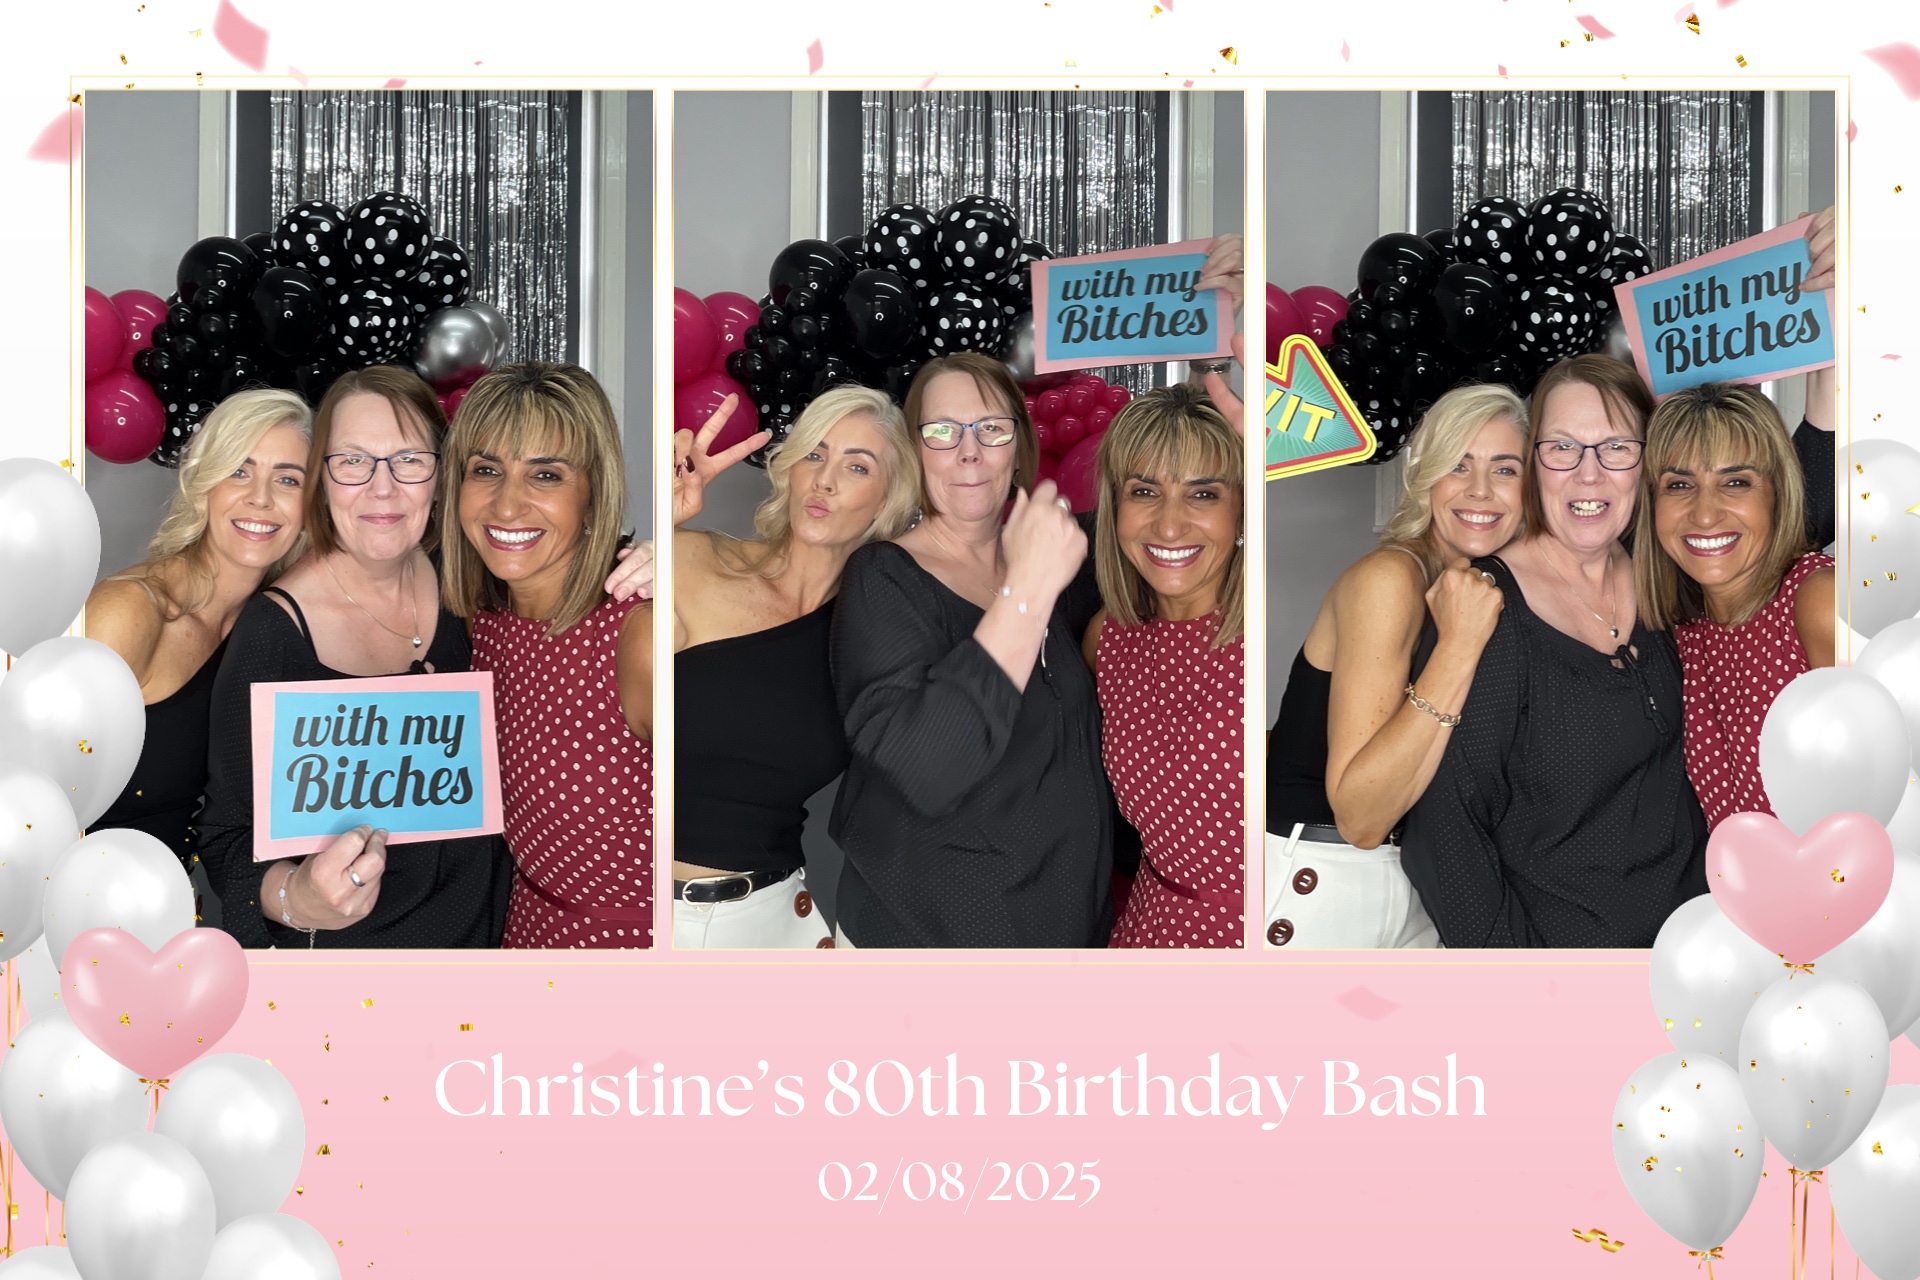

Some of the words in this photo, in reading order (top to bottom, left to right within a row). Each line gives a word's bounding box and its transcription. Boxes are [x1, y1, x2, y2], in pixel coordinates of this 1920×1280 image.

[1061, 268, 1135, 301] with
[1144, 270, 1202, 302] my
[1652, 275, 1731, 326] with
[1741, 262, 1802, 305] my
[1057, 302, 1208, 343] Bitches
[1655, 308, 1821, 375] Bitches
[292, 703, 388, 747] with
[399, 714, 465, 758] my
[286, 753, 473, 813] Bitches
